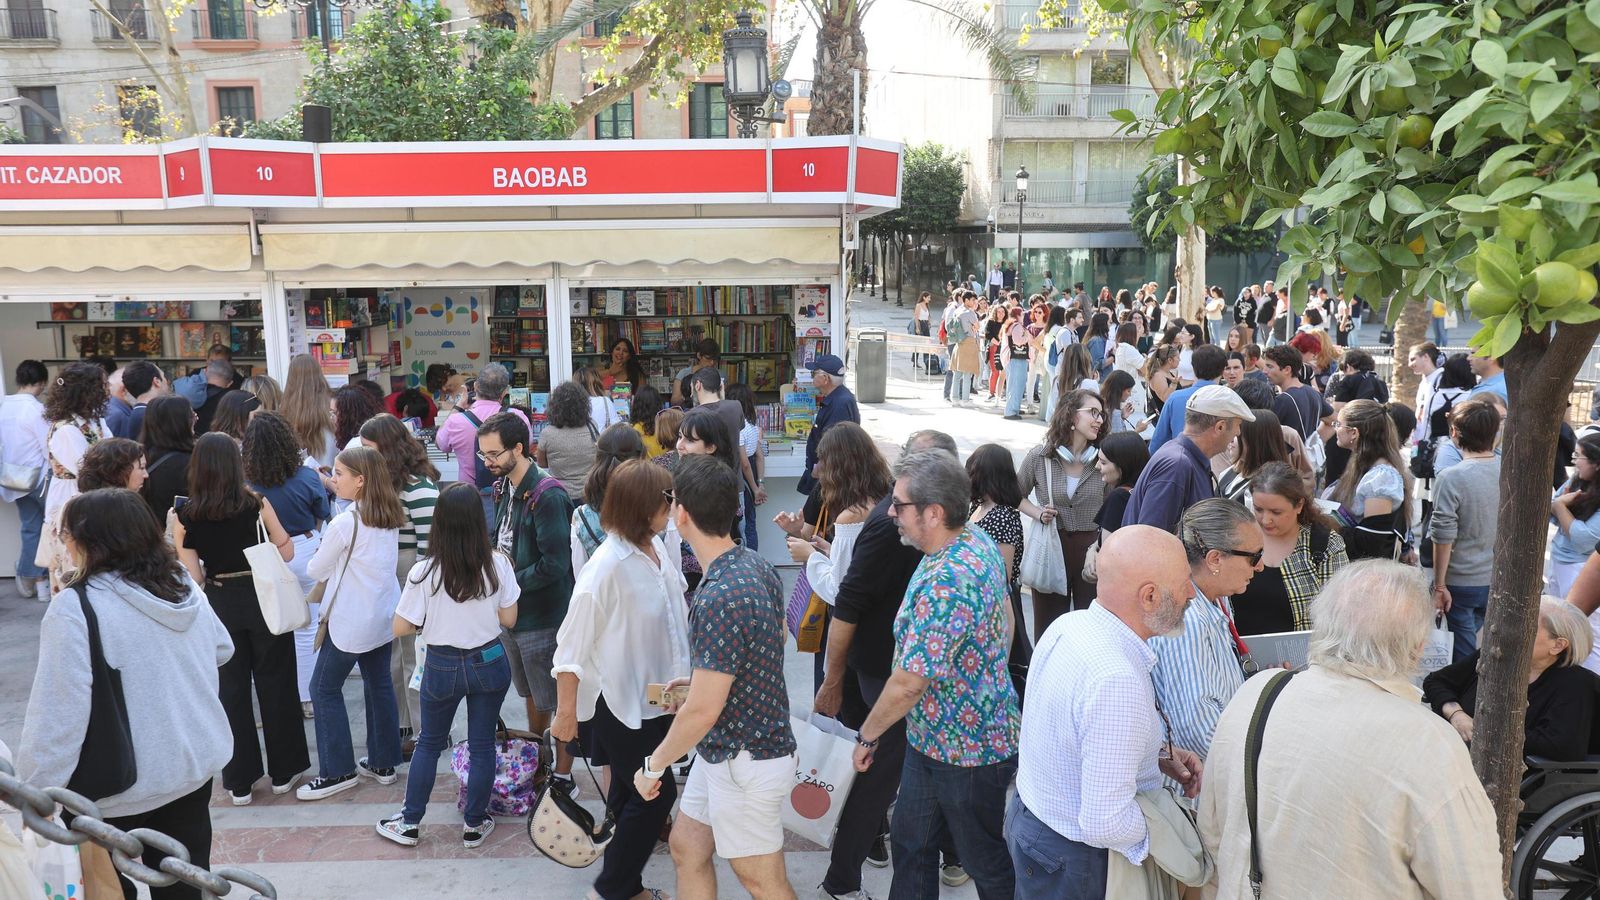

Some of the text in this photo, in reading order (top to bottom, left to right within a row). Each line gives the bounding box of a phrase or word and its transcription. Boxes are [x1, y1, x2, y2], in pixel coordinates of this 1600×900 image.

[0, 166, 123, 184] IT. CAZADOR
[179, 166, 185, 181] 9
[256, 166, 273, 181] 10
[493, 166, 588, 188] BAOBAB
[802, 163, 815, 177] 10
[414, 329, 471, 337] baobablibros.es
[415, 348, 438, 356] Libros
[803, 775, 834, 792] ZAPO
